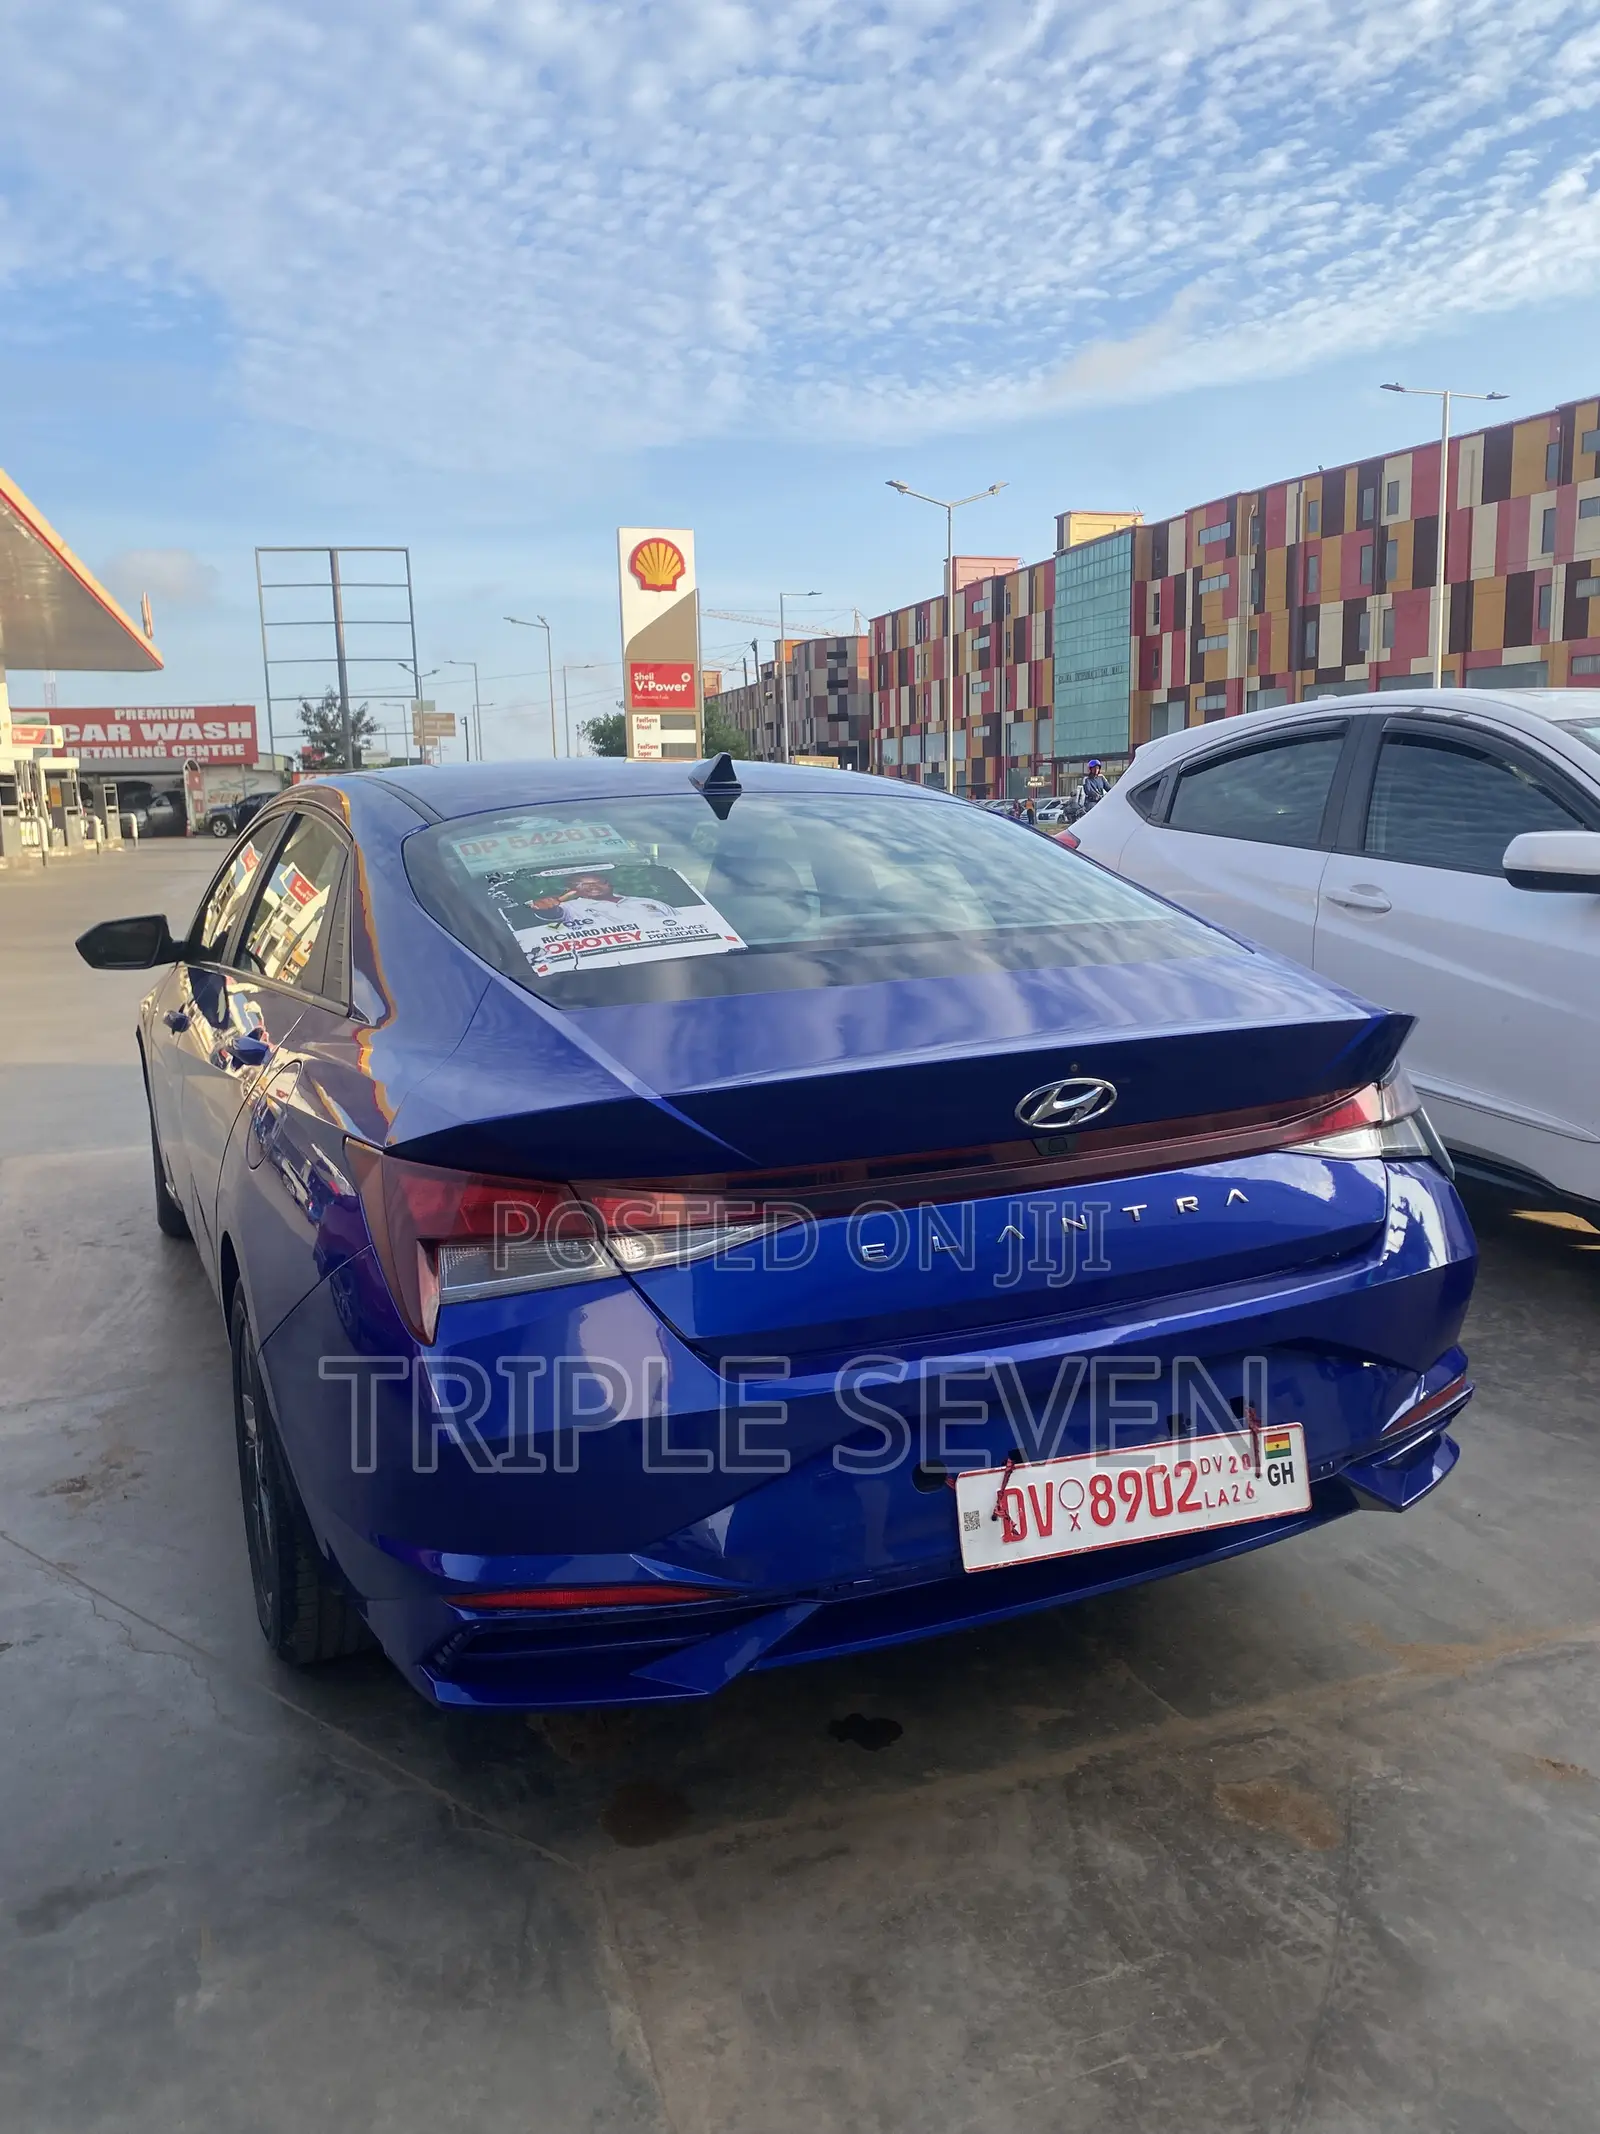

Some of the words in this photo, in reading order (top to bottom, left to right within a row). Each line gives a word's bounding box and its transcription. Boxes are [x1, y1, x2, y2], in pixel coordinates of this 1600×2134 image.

[634, 672, 655, 681] Shell
[635, 681, 687, 692] V-Power
[114, 708, 195, 720] PREMIUM
[61, 723, 132, 742] CAR
[140, 722, 252, 741] WASH
[66, 745, 167, 758] DETAILING
[171, 744, 246, 757] CENTRE
[541, 928, 601, 944] RICHARD
[601, 923, 640, 935] KWESI
[544, 931, 642, 954] OBOTEY
[647, 928, 709, 940] PRESIDENT
[860, 1188, 1250, 1262] ELANTRA
[1267, 1460, 1295, 1488] GH
[1089, 1459, 1203, 1527] 8902
